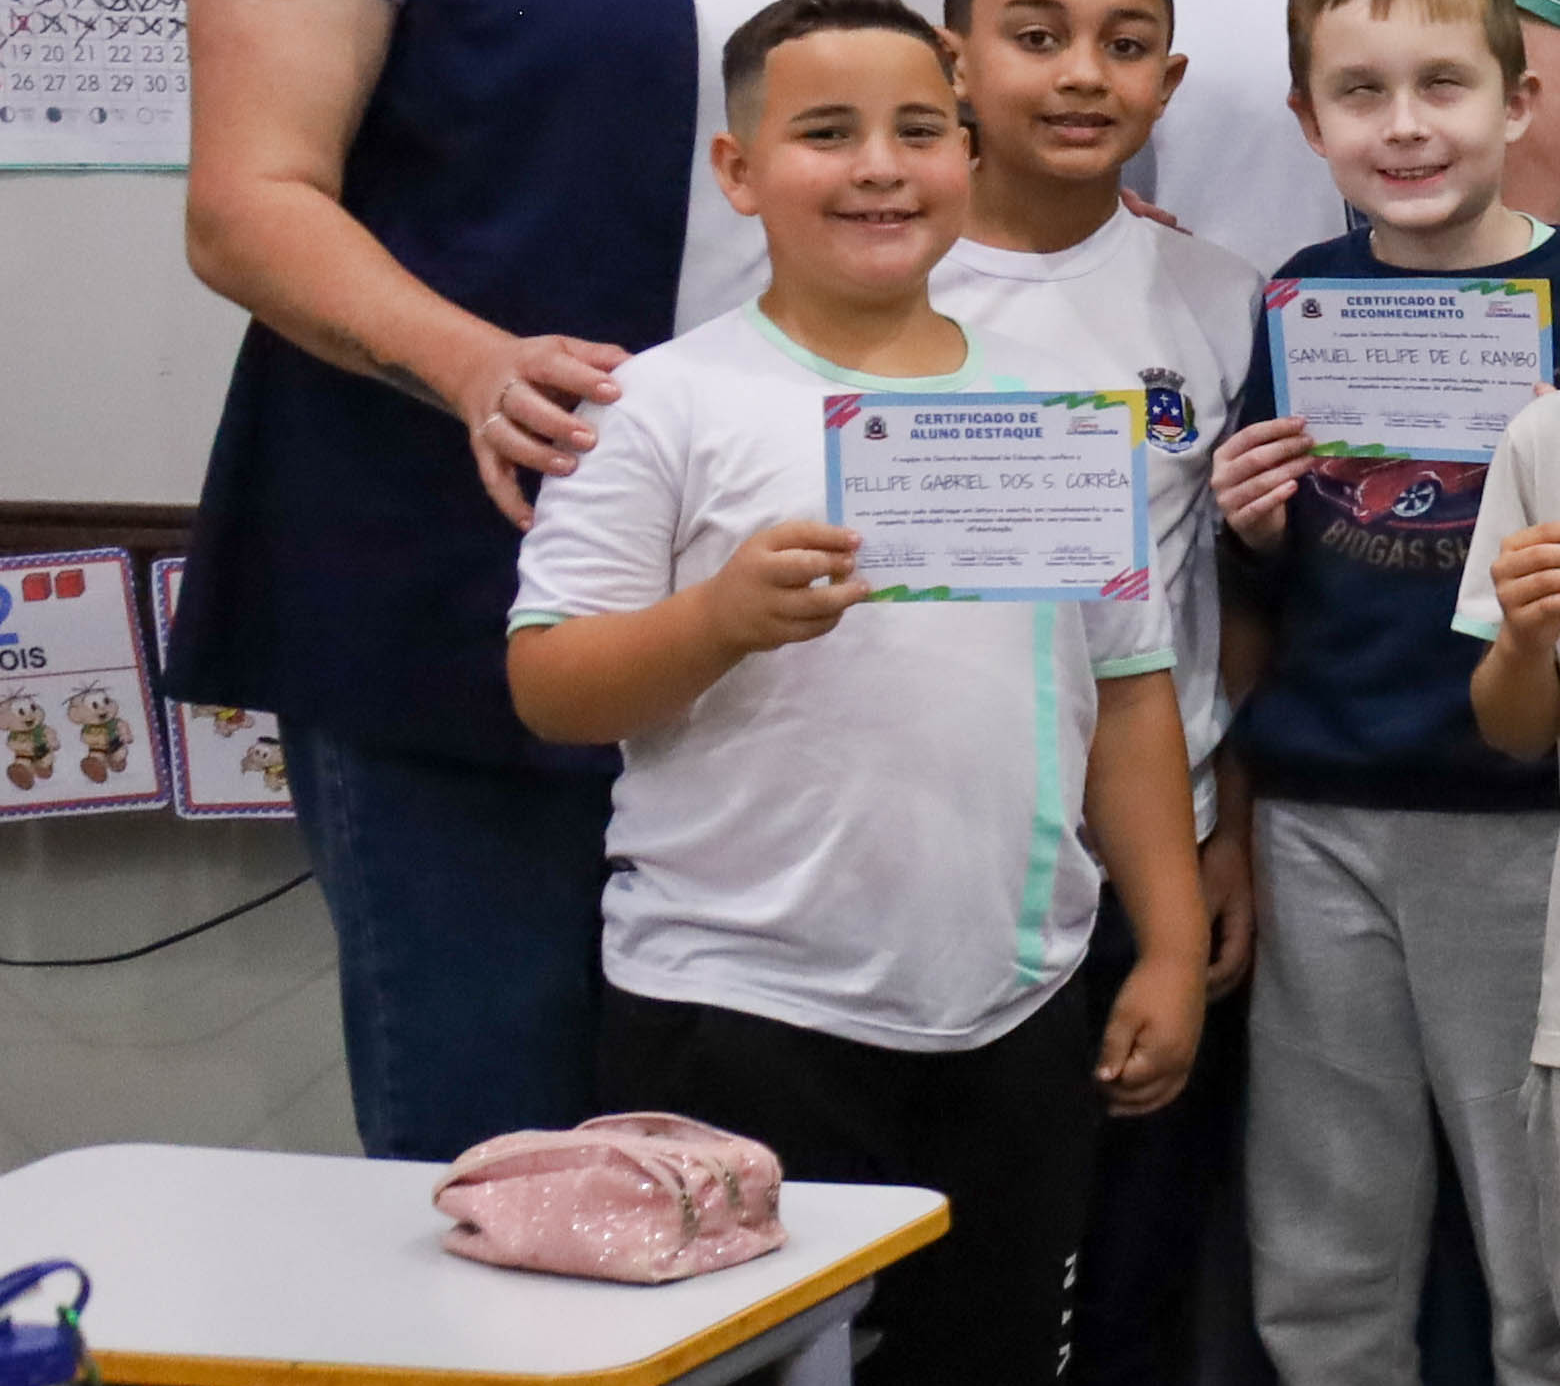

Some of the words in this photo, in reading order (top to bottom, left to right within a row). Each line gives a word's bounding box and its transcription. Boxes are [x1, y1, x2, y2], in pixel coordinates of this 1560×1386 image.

[1340, 307, 1464, 319] RECONHECIMENTO
[1288, 348, 1357, 364] SAMUEL
[1365, 348, 1419, 364] FELIPE
[1481, 350, 1537, 368] RAMBO
[845, 475, 912, 493] FELLIPE
[920, 474, 991, 491] GABRIEL
[1000, 473, 1033, 490] DOS
[1066, 469, 1130, 490] CORRÊA
